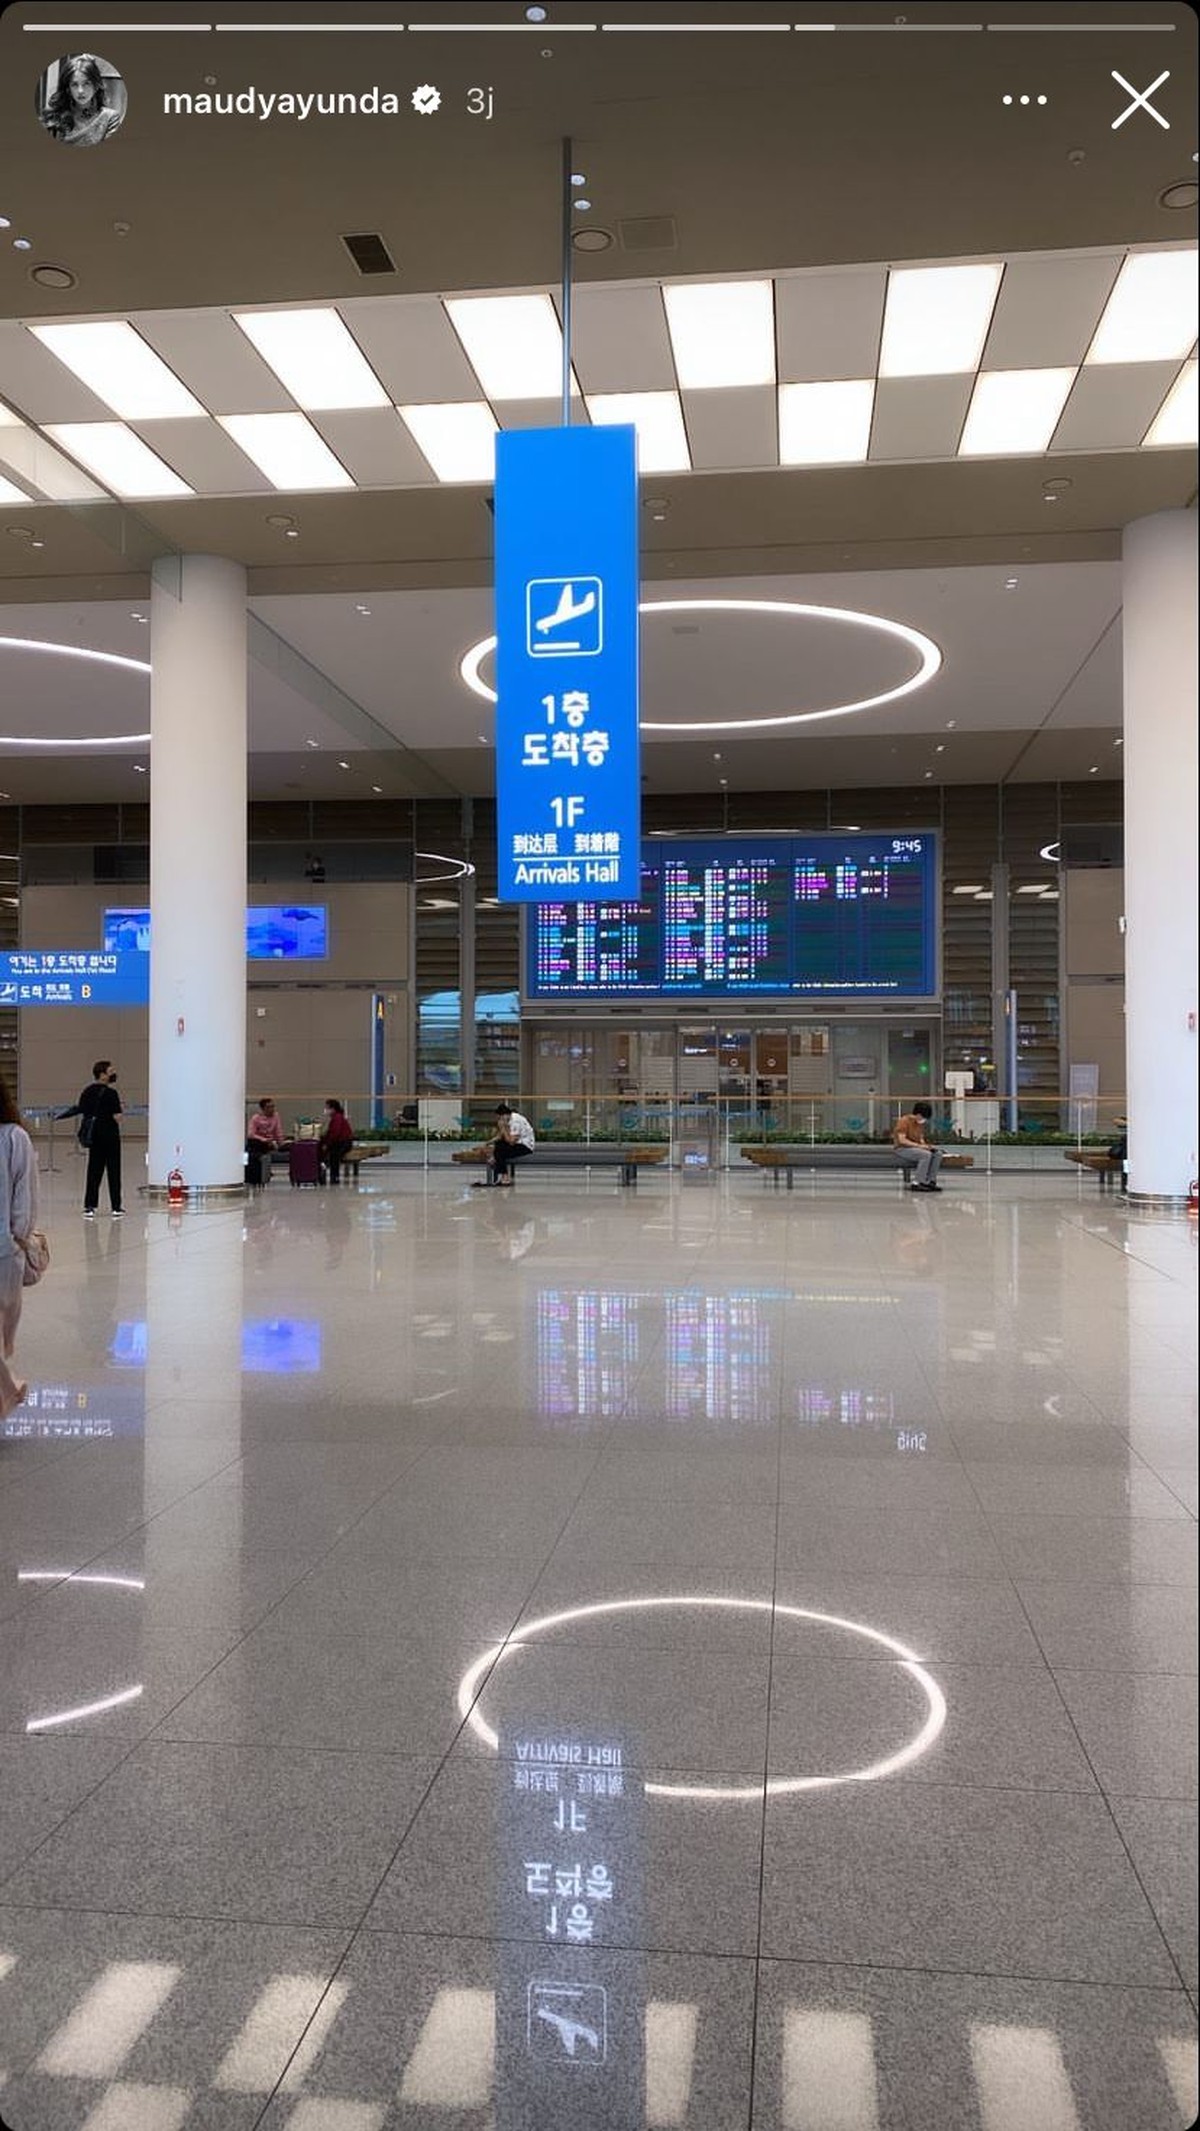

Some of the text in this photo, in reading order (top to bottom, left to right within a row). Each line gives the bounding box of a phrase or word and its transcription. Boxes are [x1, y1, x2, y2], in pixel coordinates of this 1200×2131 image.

[541, 690, 589, 728] 1층
[521, 730, 609, 767] 도착층
[549, 796, 584, 828] 1F
[513, 832, 558, 854] 到达层
[892, 839, 922, 853] 9:45
[514, 861, 580, 884] Arrivals
[585, 859, 619, 883] Hall
[81, 984, 91, 998] B
